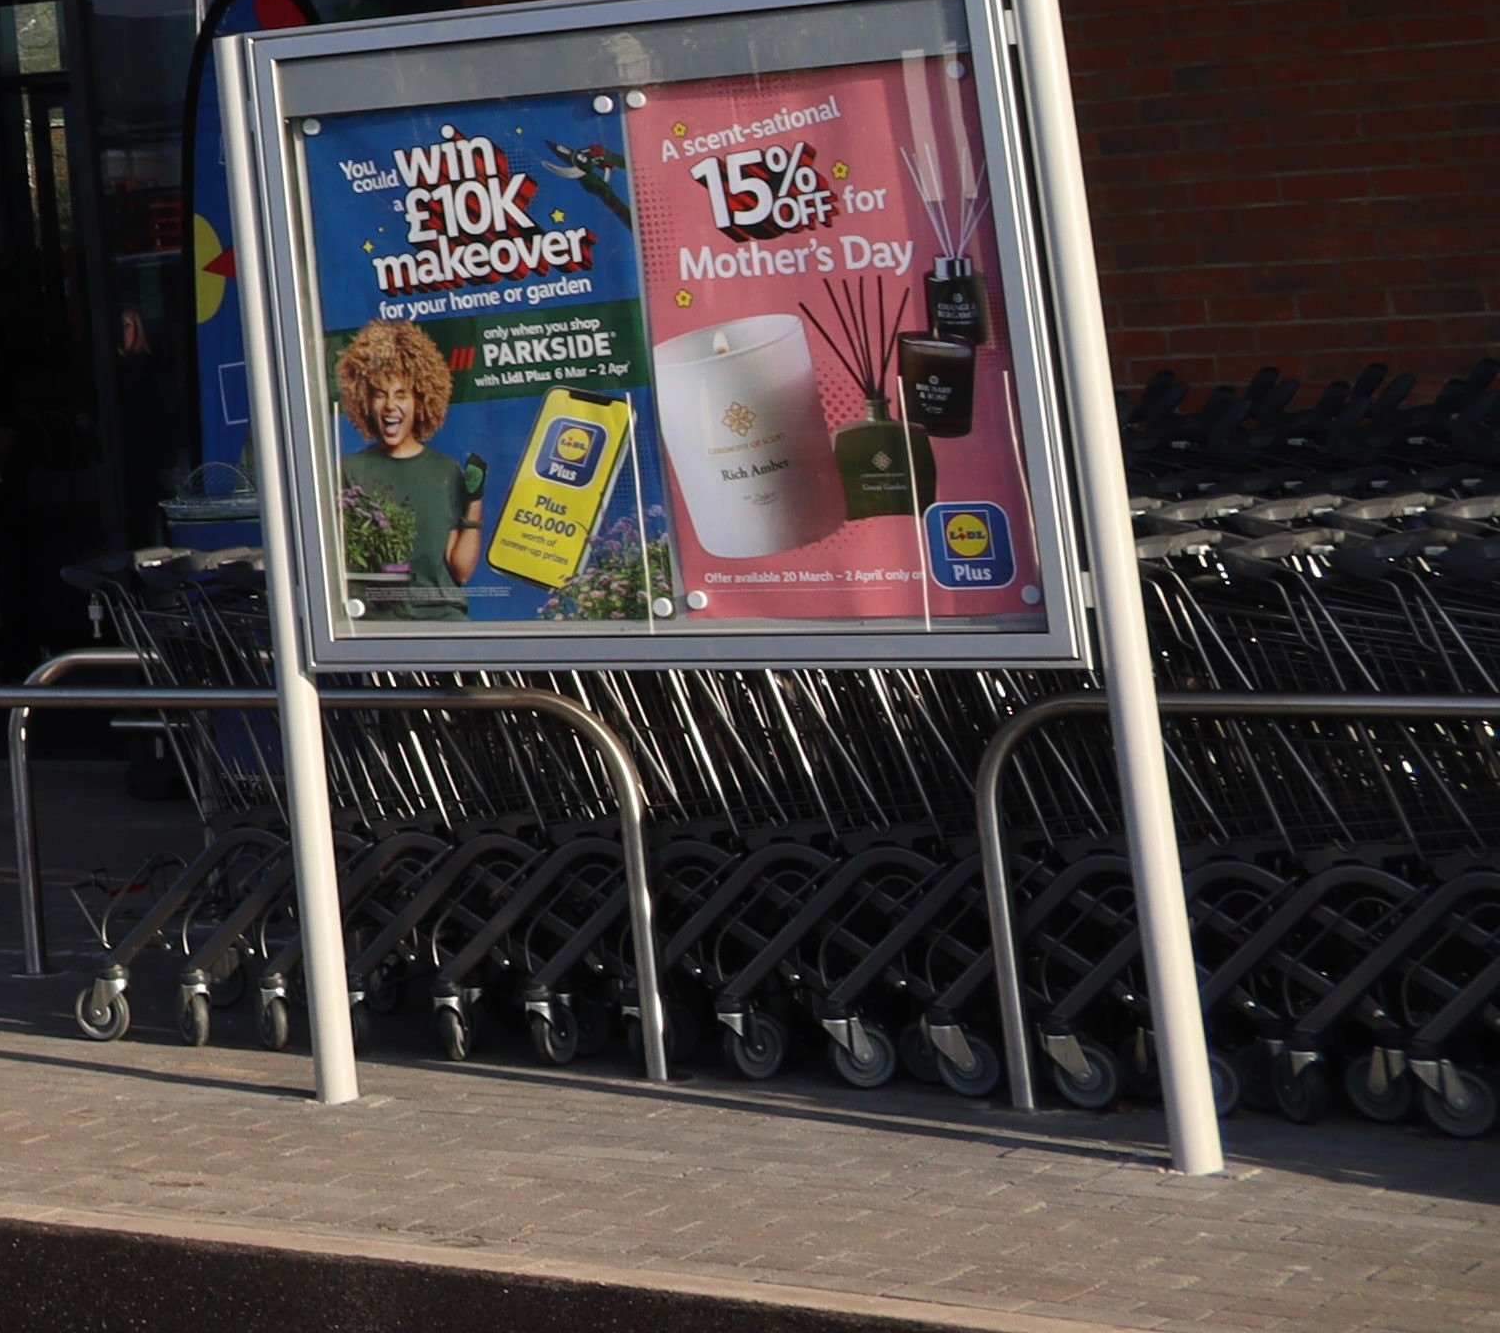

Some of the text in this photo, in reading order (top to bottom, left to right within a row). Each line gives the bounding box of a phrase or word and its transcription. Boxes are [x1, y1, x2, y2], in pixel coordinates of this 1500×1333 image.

[662, 96, 841, 162] A scent-sational
[339, 159, 377, 181] You
[394, 125, 497, 187] win
[352, 170, 399, 193] could
[690, 142, 817, 228] 15%
[393, 173, 535, 243] a £10K
[773, 191, 832, 228] OFF
[843, 185, 887, 213] for
[372, 227, 586, 290] makeover
[680, 235, 914, 281] Mother's Day
[380, 277, 592, 321] for your home or garden
[484, 317, 600, 340] only when you shop
[474, 374, 500, 387] with
[501, 371, 525, 385] Lidl
[526, 370, 551, 383] Plus
[554, 368, 562, 380] 6
[564, 366, 587, 379] Mar
[598, 363, 607, 375] 2
[549, 462, 577, 482] Plus
[721, 458, 790, 481] Rich Amber
[535, 495, 568, 516] Plus
[513, 508, 576, 538] £50,000
[704, 572, 732, 584] Offer
[734, 571, 781, 583] available
[783, 570, 796, 582] 20
[799, 569, 834, 582] March
[845, 570, 852, 581] 2
[885, 569, 909, 584] only
[952, 564, 993, 582] Plus
